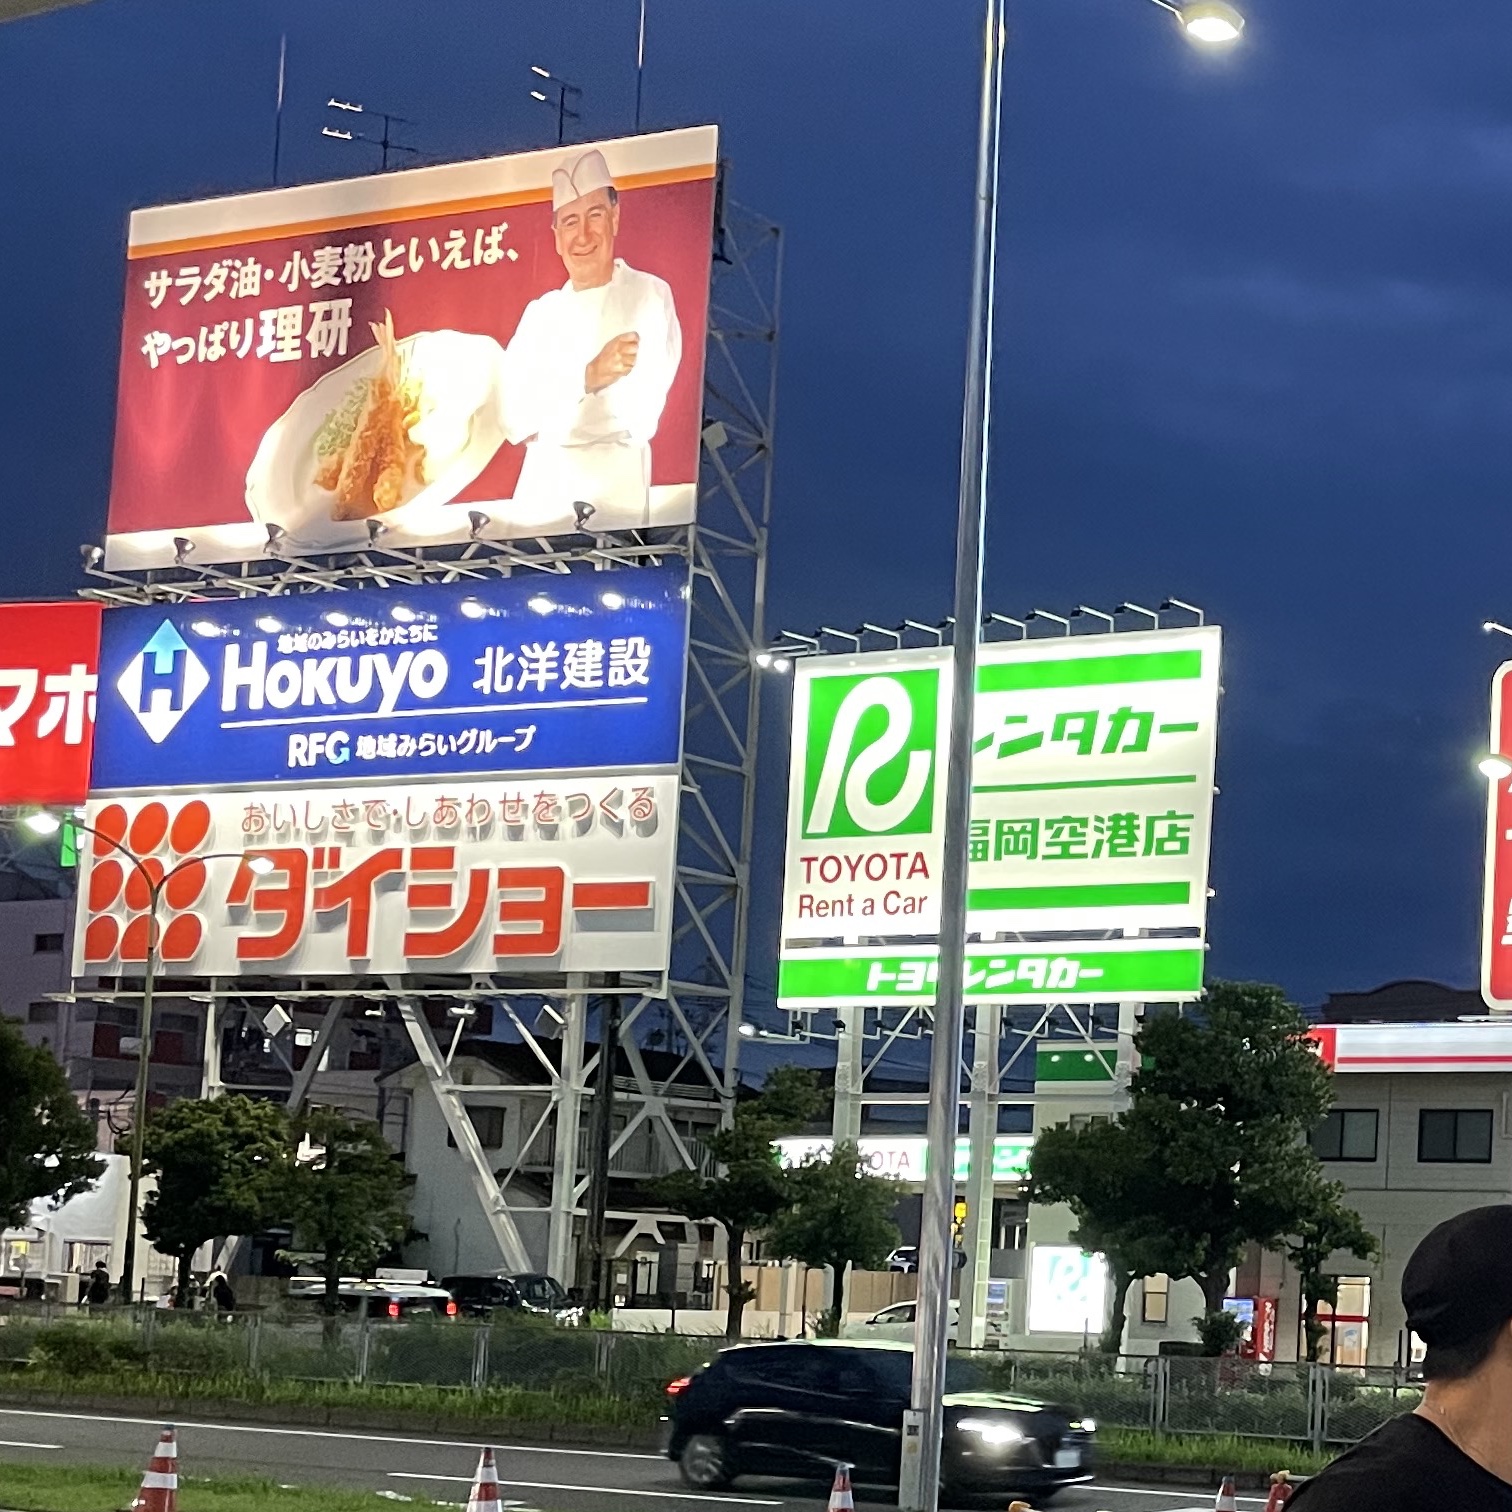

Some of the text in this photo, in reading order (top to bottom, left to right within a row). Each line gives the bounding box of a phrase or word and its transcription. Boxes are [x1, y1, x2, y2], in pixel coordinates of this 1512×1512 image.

[144, 222, 519, 309] サラダ油・小麦粉といえば、
[141, 298, 353, 369] やっぱり理研
[472, 636, 651, 695] 北洋建設
[355, 726, 537, 760] 地域みらいグループ
[800, 851, 930, 884] TOYOTA
[225, 846, 652, 960] ダイショー
[798, 890, 928, 918] Rent a Car
